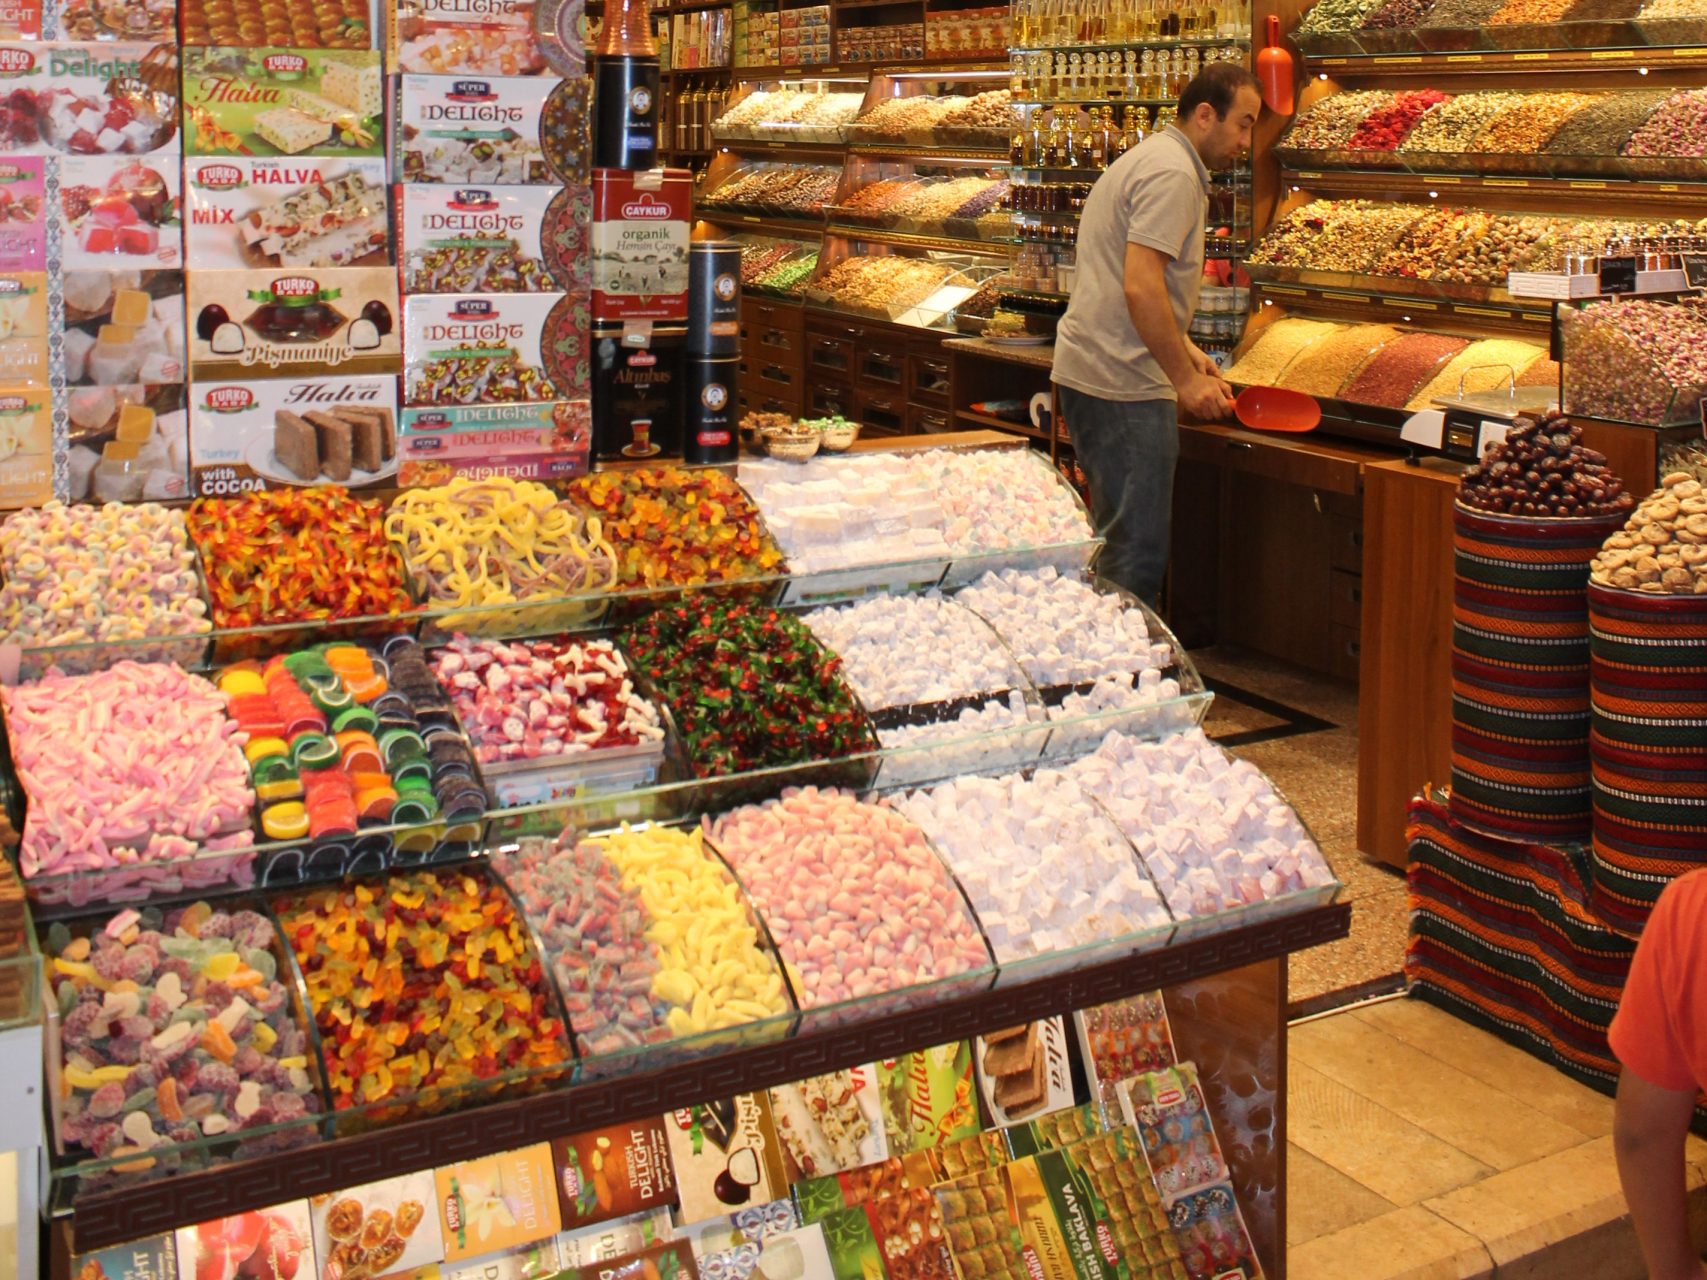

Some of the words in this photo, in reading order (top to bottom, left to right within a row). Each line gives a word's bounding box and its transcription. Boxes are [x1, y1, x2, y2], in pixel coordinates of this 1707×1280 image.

[50, 58, 141, 81] Delight
[202, 168, 238, 179] TURKO
[252, 169, 324, 185] HALVA
[622, 228, 670, 243] organik
[276, 280, 315, 291] TURKO
[211, 392, 249, 403] TURKO
[201, 467, 236, 481] with
[202, 478, 266, 496] COCOA
[1044, 1019, 1063, 1090] alva
[630, 1130, 654, 1200] DELIGHT
[1062, 1183, 1093, 1252] BAKLAVA
